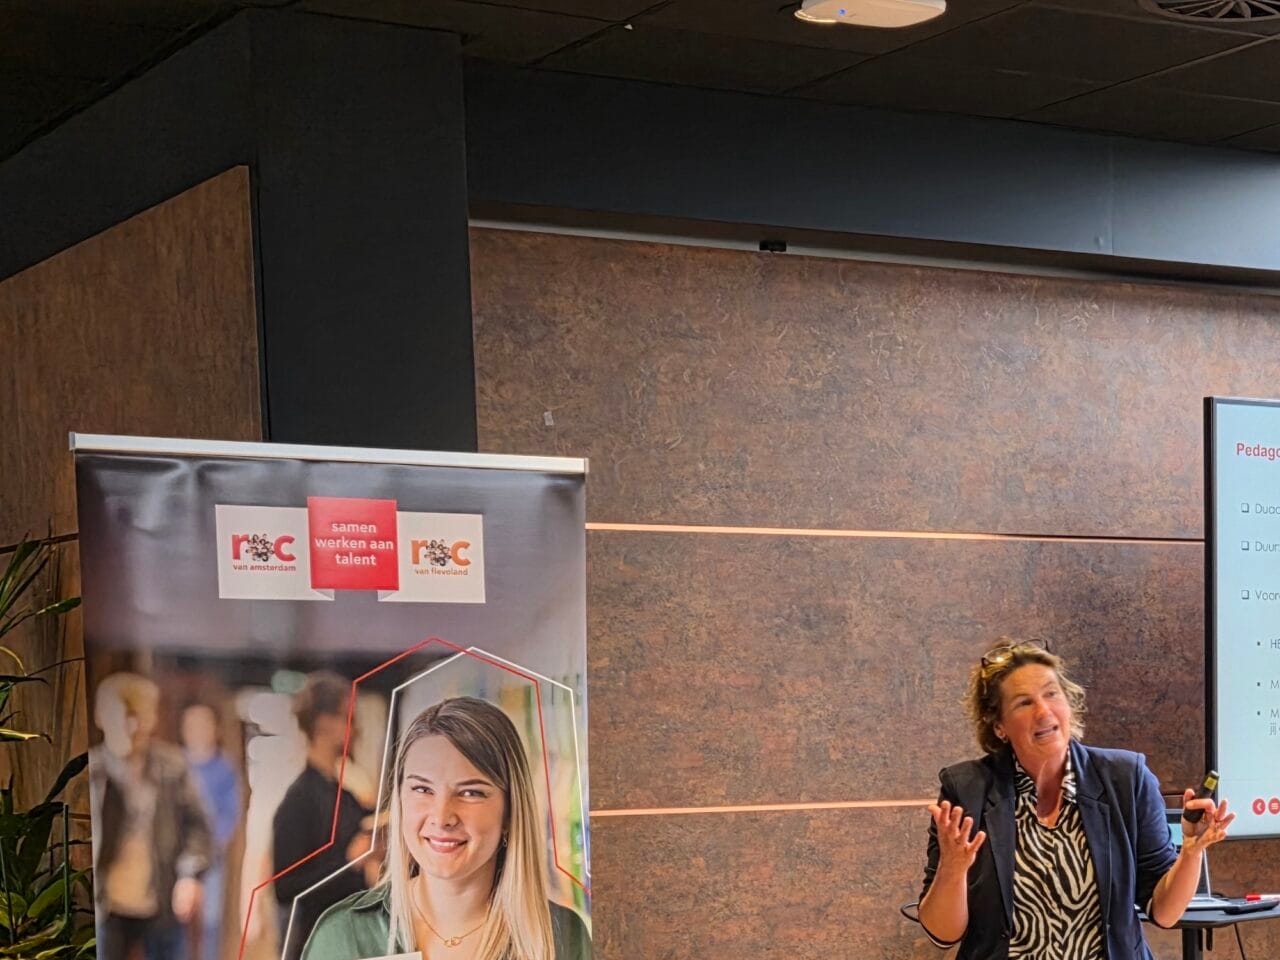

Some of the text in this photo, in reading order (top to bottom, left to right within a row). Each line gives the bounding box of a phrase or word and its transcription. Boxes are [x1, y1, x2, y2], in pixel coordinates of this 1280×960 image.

[331, 520, 377, 534] samen
[314, 536, 394, 551] werken aan
[1255, 541, 1280, 552] Duur:
[334, 552, 377, 567] talent
[250, 563, 297, 572] amsterdam
[431, 567, 469, 576] flevoland
[1269, 722, 1277, 736] jij
